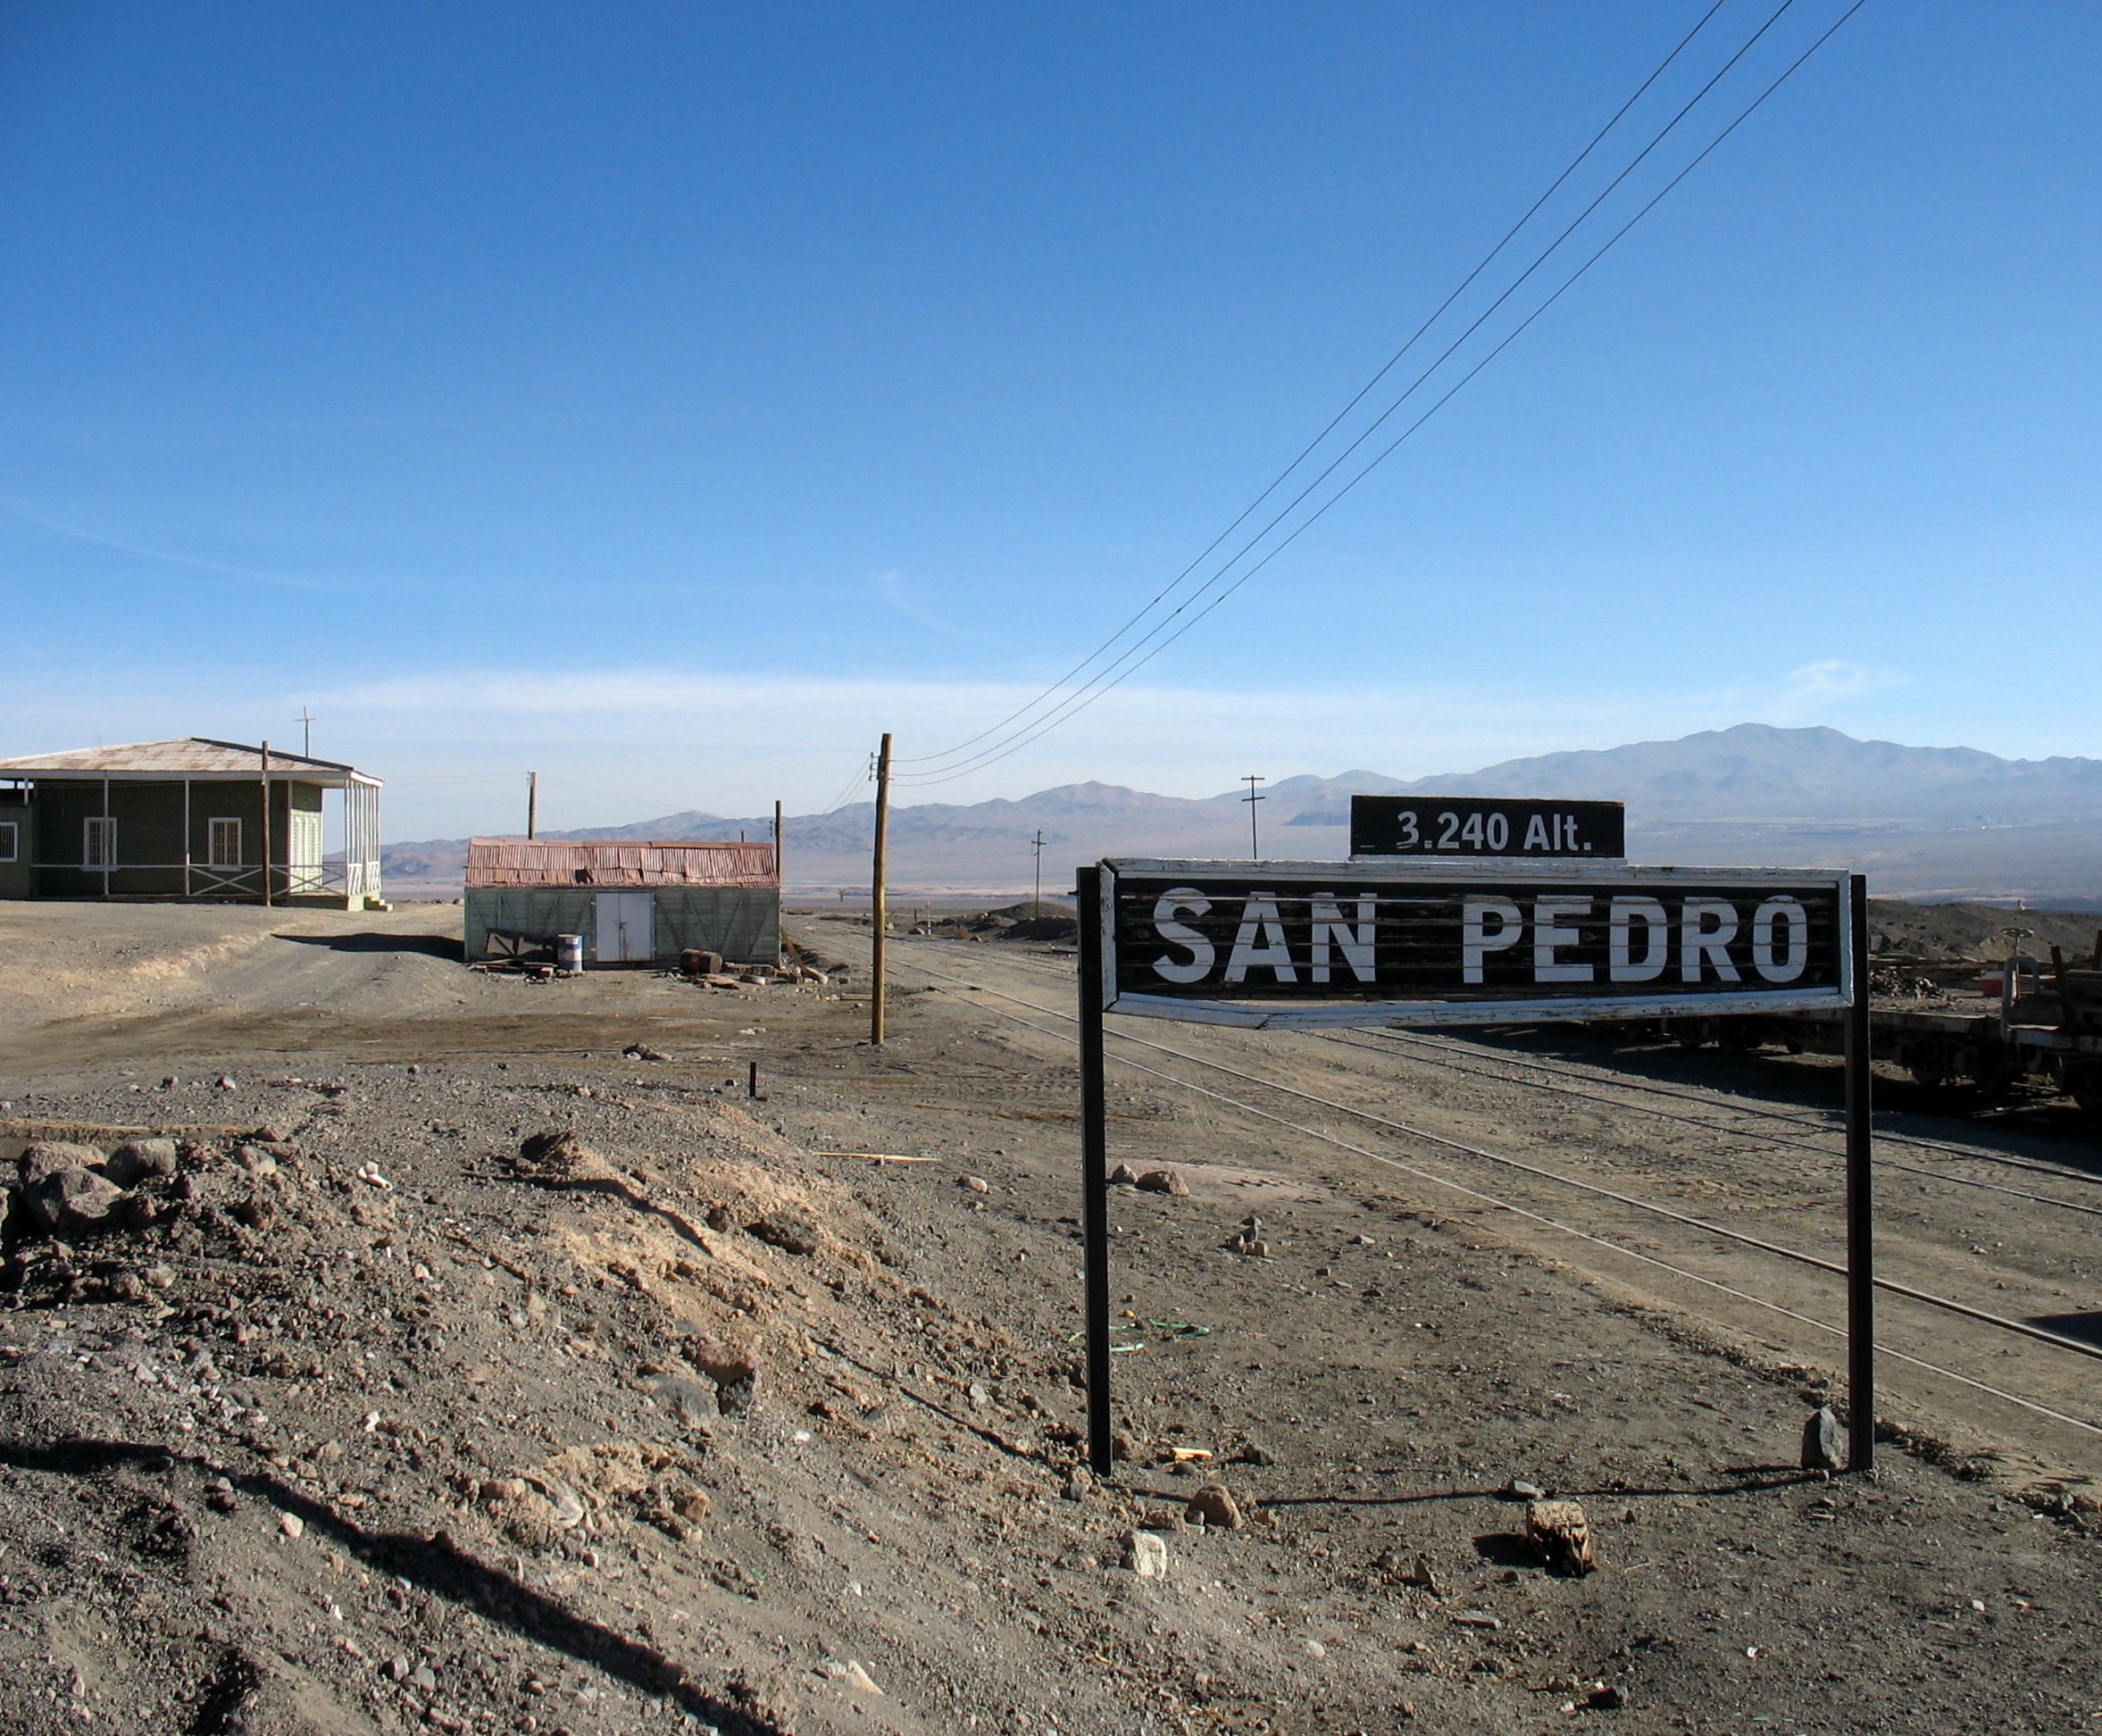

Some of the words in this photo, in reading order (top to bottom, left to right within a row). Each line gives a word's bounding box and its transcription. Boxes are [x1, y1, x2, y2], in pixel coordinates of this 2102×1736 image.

[1396, 810, 1509, 850] 3.240
[1523, 814, 1592, 851] Alt.
[1151, 887, 1377, 984] SAN
[1462, 894, 1808, 983] PEDRO
